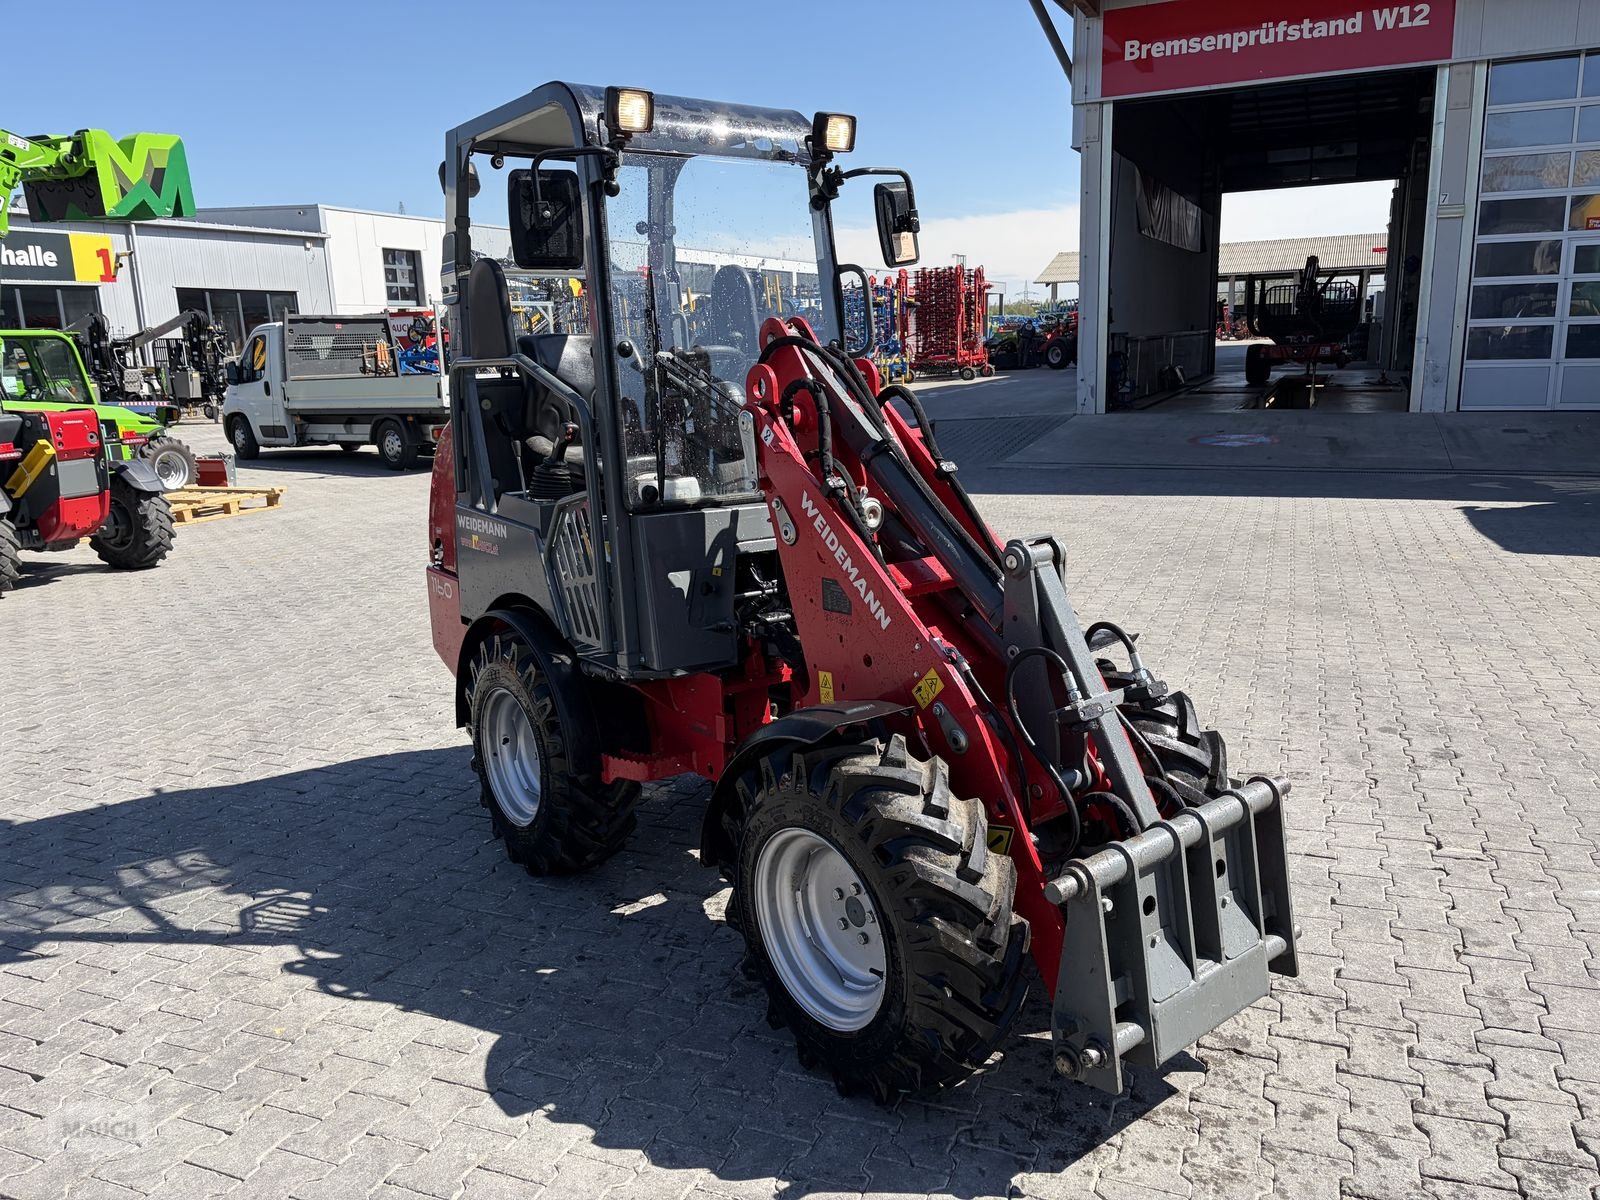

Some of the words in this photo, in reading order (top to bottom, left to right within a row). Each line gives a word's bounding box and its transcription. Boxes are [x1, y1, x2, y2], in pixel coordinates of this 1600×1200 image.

[1124, 11, 1362, 62] Bremsenprüfstand
[1372, 3, 1431, 31] W12
[1441, 193, 1448, 203] 7
[1, 243, 58, 267] halle
[96, 248, 117, 282] 1
[457, 514, 508, 539] WEIDEMANN
[801, 489, 892, 631] WEIDEMANN
